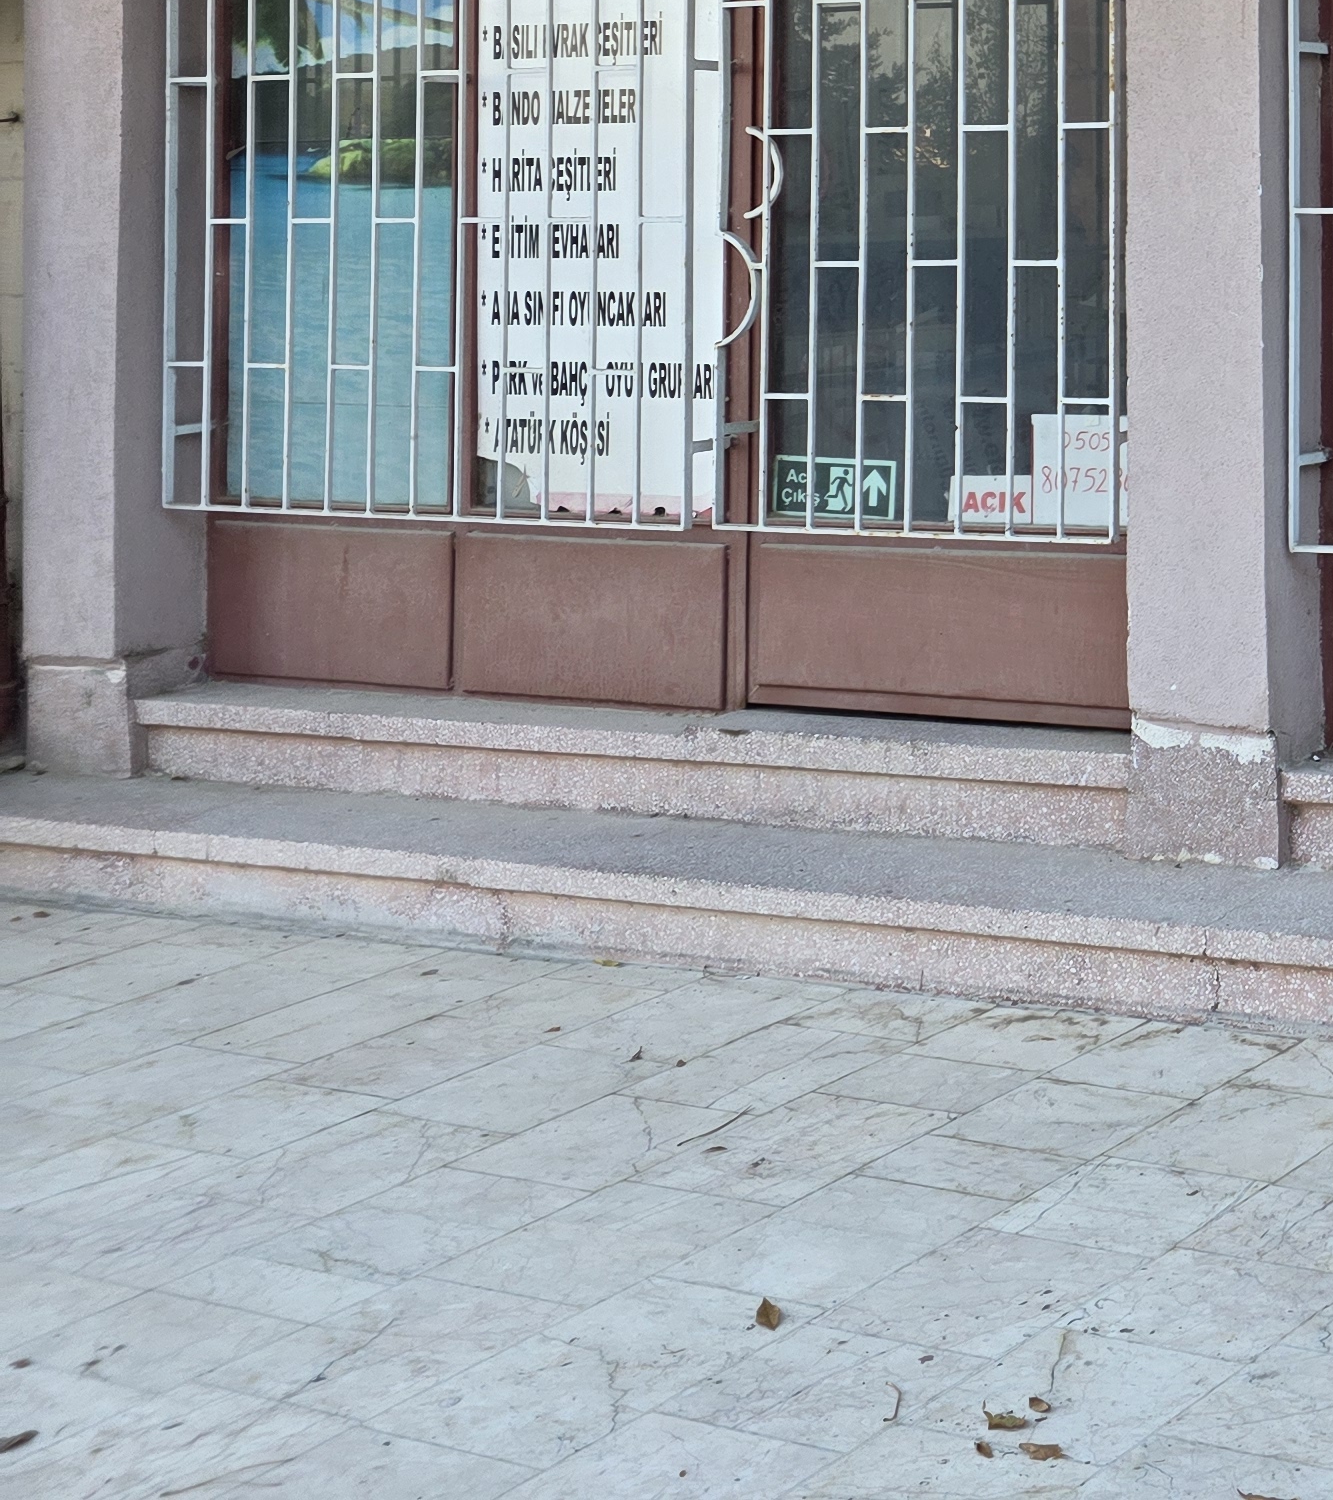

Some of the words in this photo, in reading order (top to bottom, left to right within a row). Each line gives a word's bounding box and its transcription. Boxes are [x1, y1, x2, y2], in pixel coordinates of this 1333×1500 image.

[493, 25, 538, 60] BSILI
[492, 91, 540, 126] BNDO
[552, 88, 636, 125] ALZEELER
[492, 148, 542, 192] HRİTA
[492, 215, 539, 258] EİTİM
[552, 223, 619, 258] EVHAARI
[524, 291, 564, 326] SINFI
[569, 291, 666, 327] OYNCAKARI
[491, 361, 528, 395] PRK
[551, 361, 588, 406] BAHÇ
[560, 412, 610, 465] KÖŞSİ
[781, 488, 820, 506] Çıkş
[963, 491, 1026, 517] AÇIK
